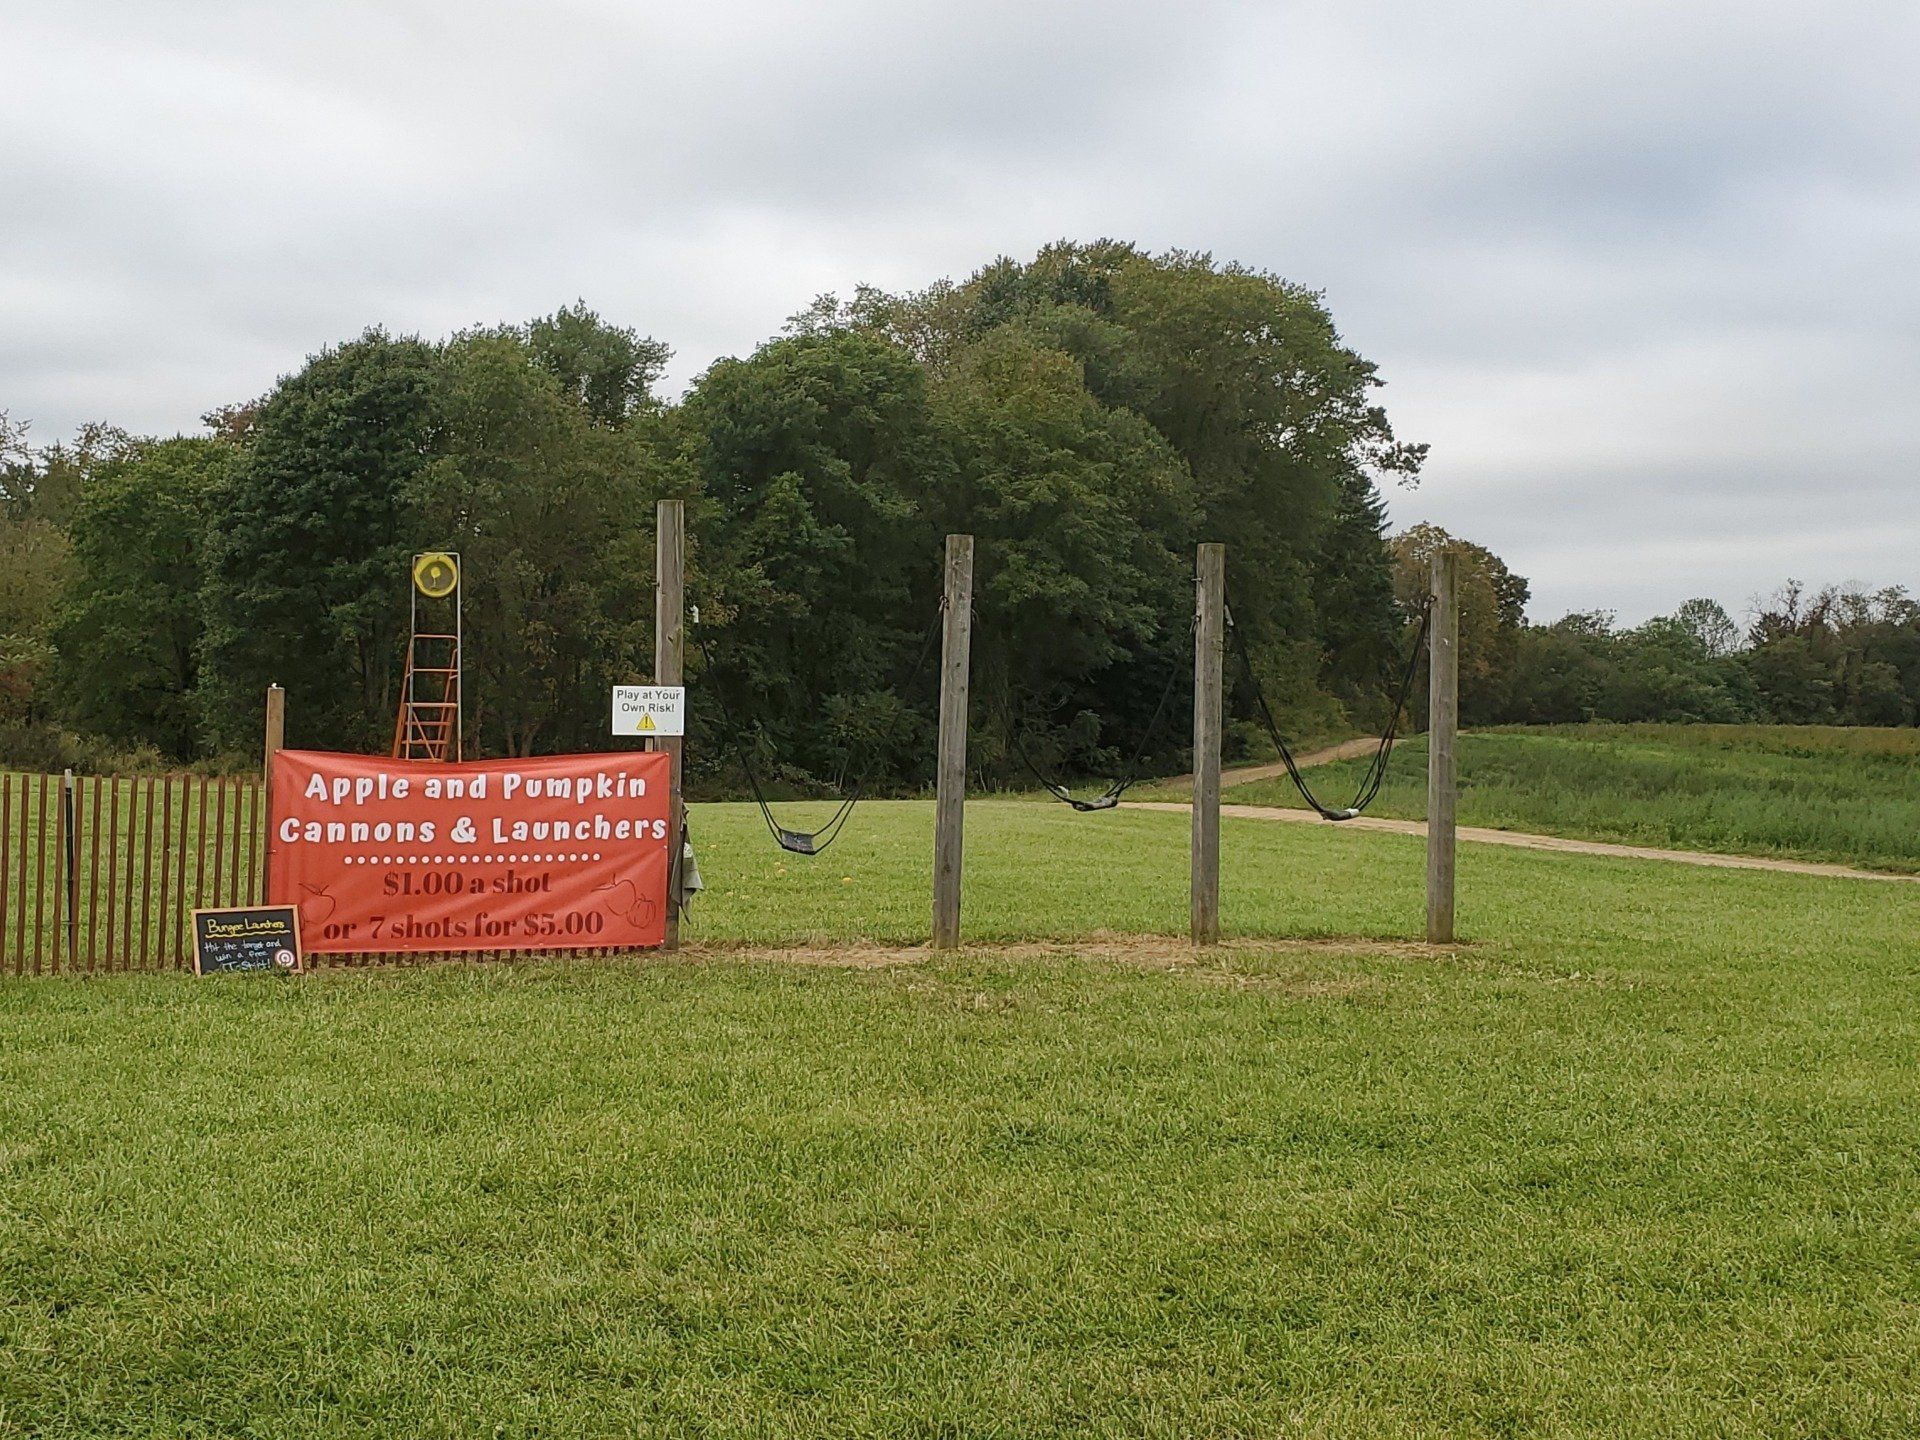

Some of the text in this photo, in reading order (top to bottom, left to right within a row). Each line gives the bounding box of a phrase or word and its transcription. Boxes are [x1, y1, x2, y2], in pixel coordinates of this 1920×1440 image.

[617, 690, 680, 701] Play at Your
[622, 703, 674, 712] Own Risk!
[304, 772, 646, 805] Apple and Pumpkin
[279, 814, 667, 844] Cannons & Launchers
[383, 869, 552, 896] $1.00 a shot
[323, 911, 604, 940] or 7 shots for $5.00
[223, 941, 238, 950] the
[266, 938, 281, 948] and
